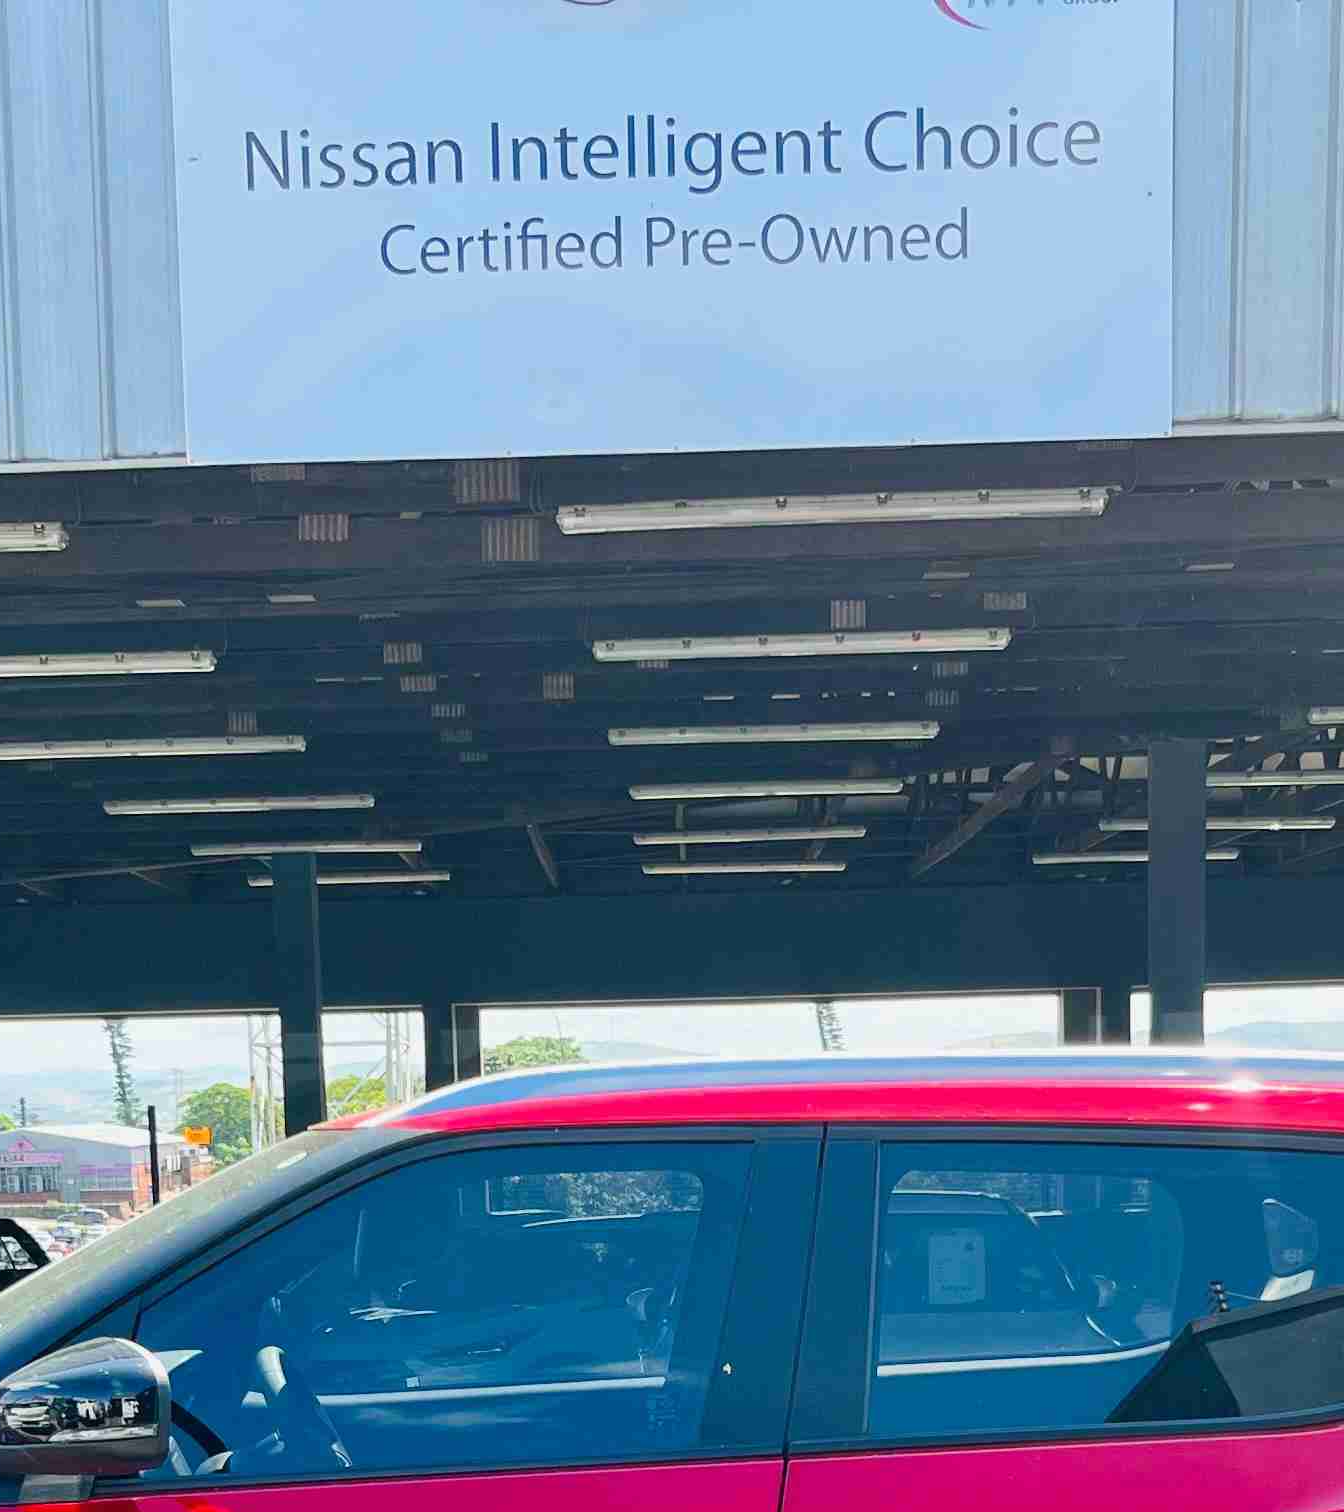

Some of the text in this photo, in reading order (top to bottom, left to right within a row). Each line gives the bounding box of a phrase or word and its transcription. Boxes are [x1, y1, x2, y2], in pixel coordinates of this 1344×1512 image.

[243, 106, 1103, 194] Nissan Intelligent Choice
[379, 207, 971, 276] Certified Pre-Owned
